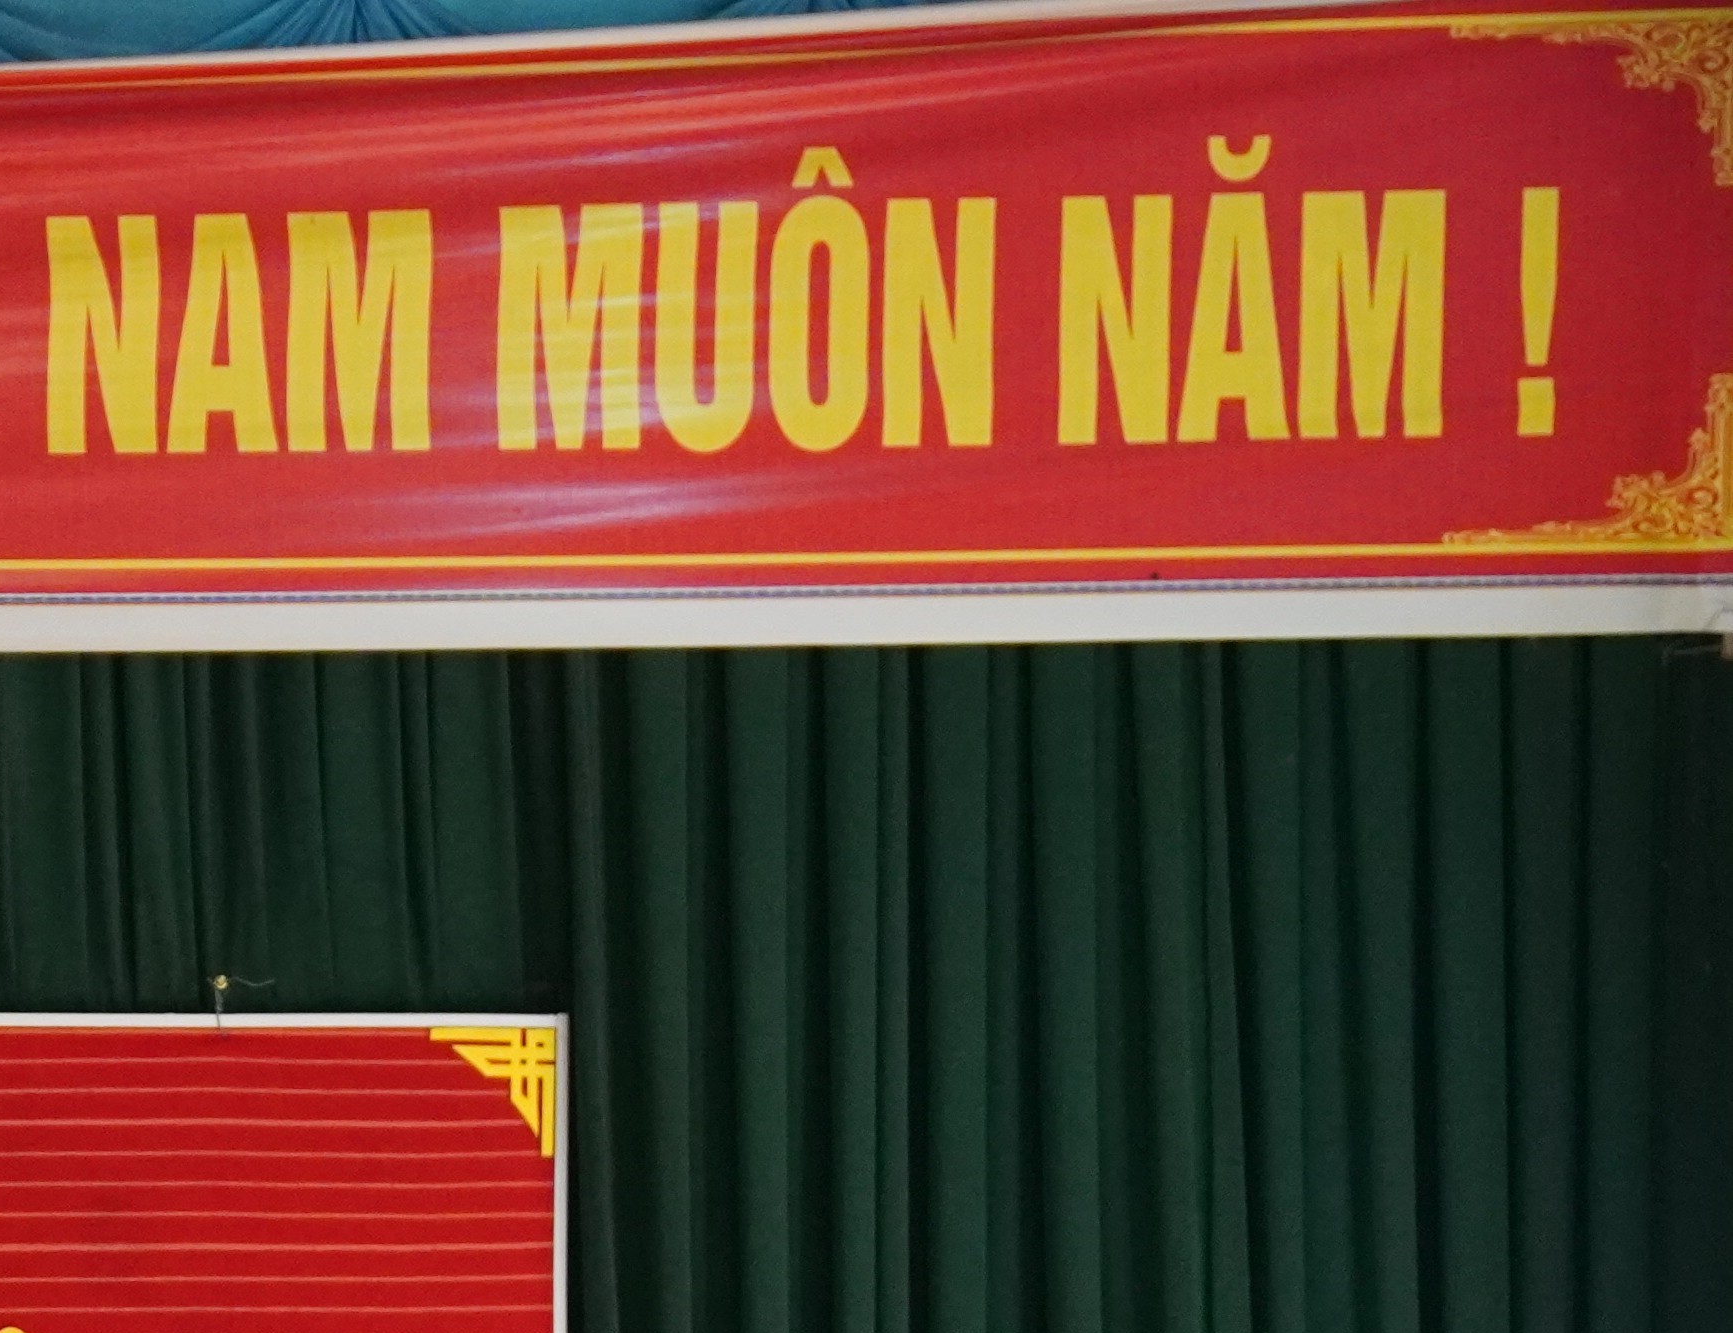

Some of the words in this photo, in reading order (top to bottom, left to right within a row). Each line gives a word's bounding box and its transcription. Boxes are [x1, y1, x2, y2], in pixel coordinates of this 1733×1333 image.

[46, 210, 433, 454] NAM
[496, 147, 996, 453] MUÔN
[1058, 135, 1446, 445] NĂM
[1517, 186, 1560, 437] !
